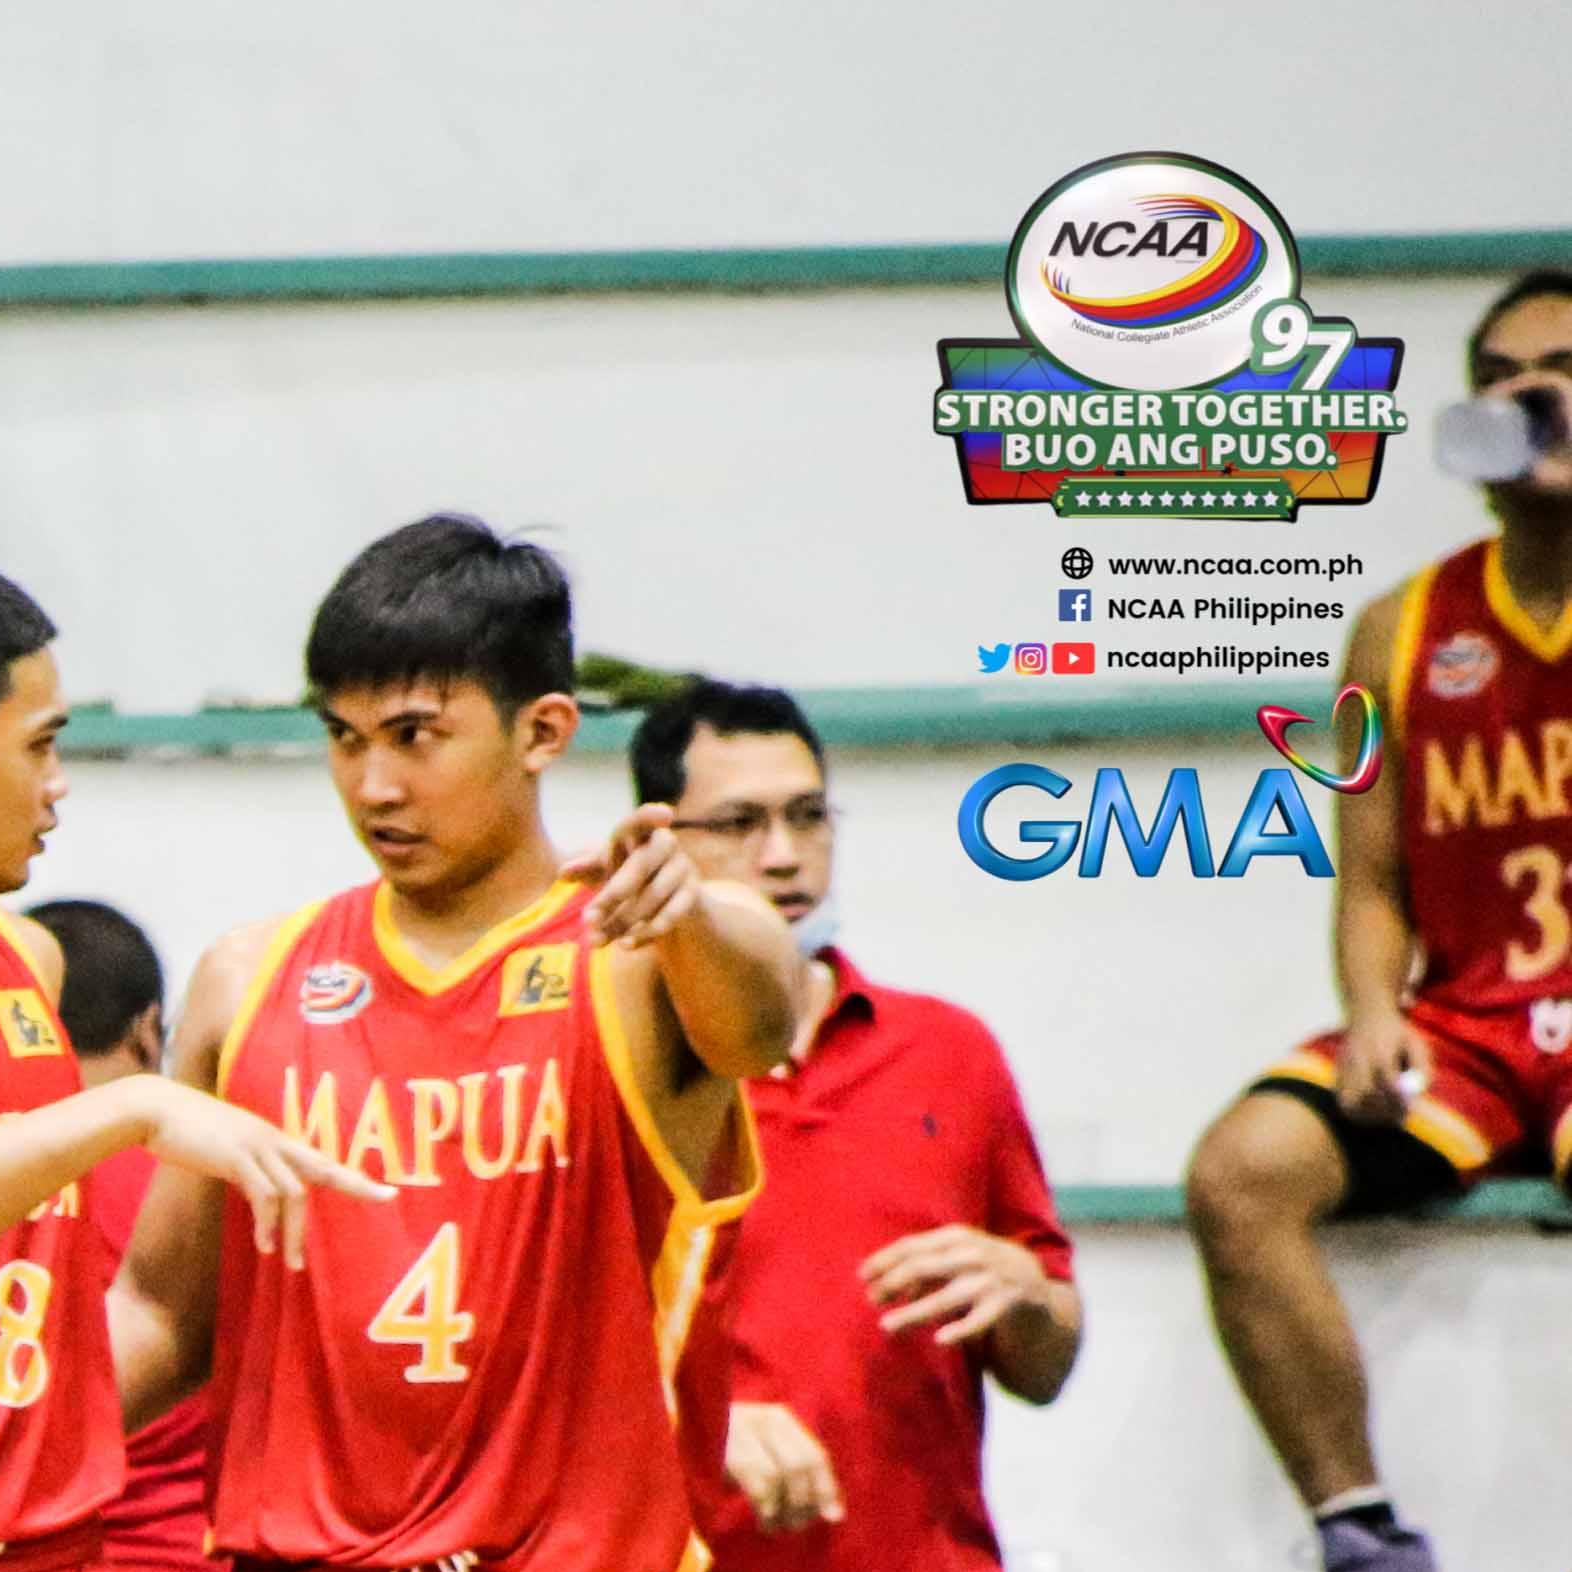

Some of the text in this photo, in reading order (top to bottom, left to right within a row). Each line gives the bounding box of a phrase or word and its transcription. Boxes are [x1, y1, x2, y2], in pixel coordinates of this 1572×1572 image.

[1501, 844, 1572, 982] 3
[280, 1056, 571, 1187] MAPUA
[368, 1221, 476, 1384] 4
